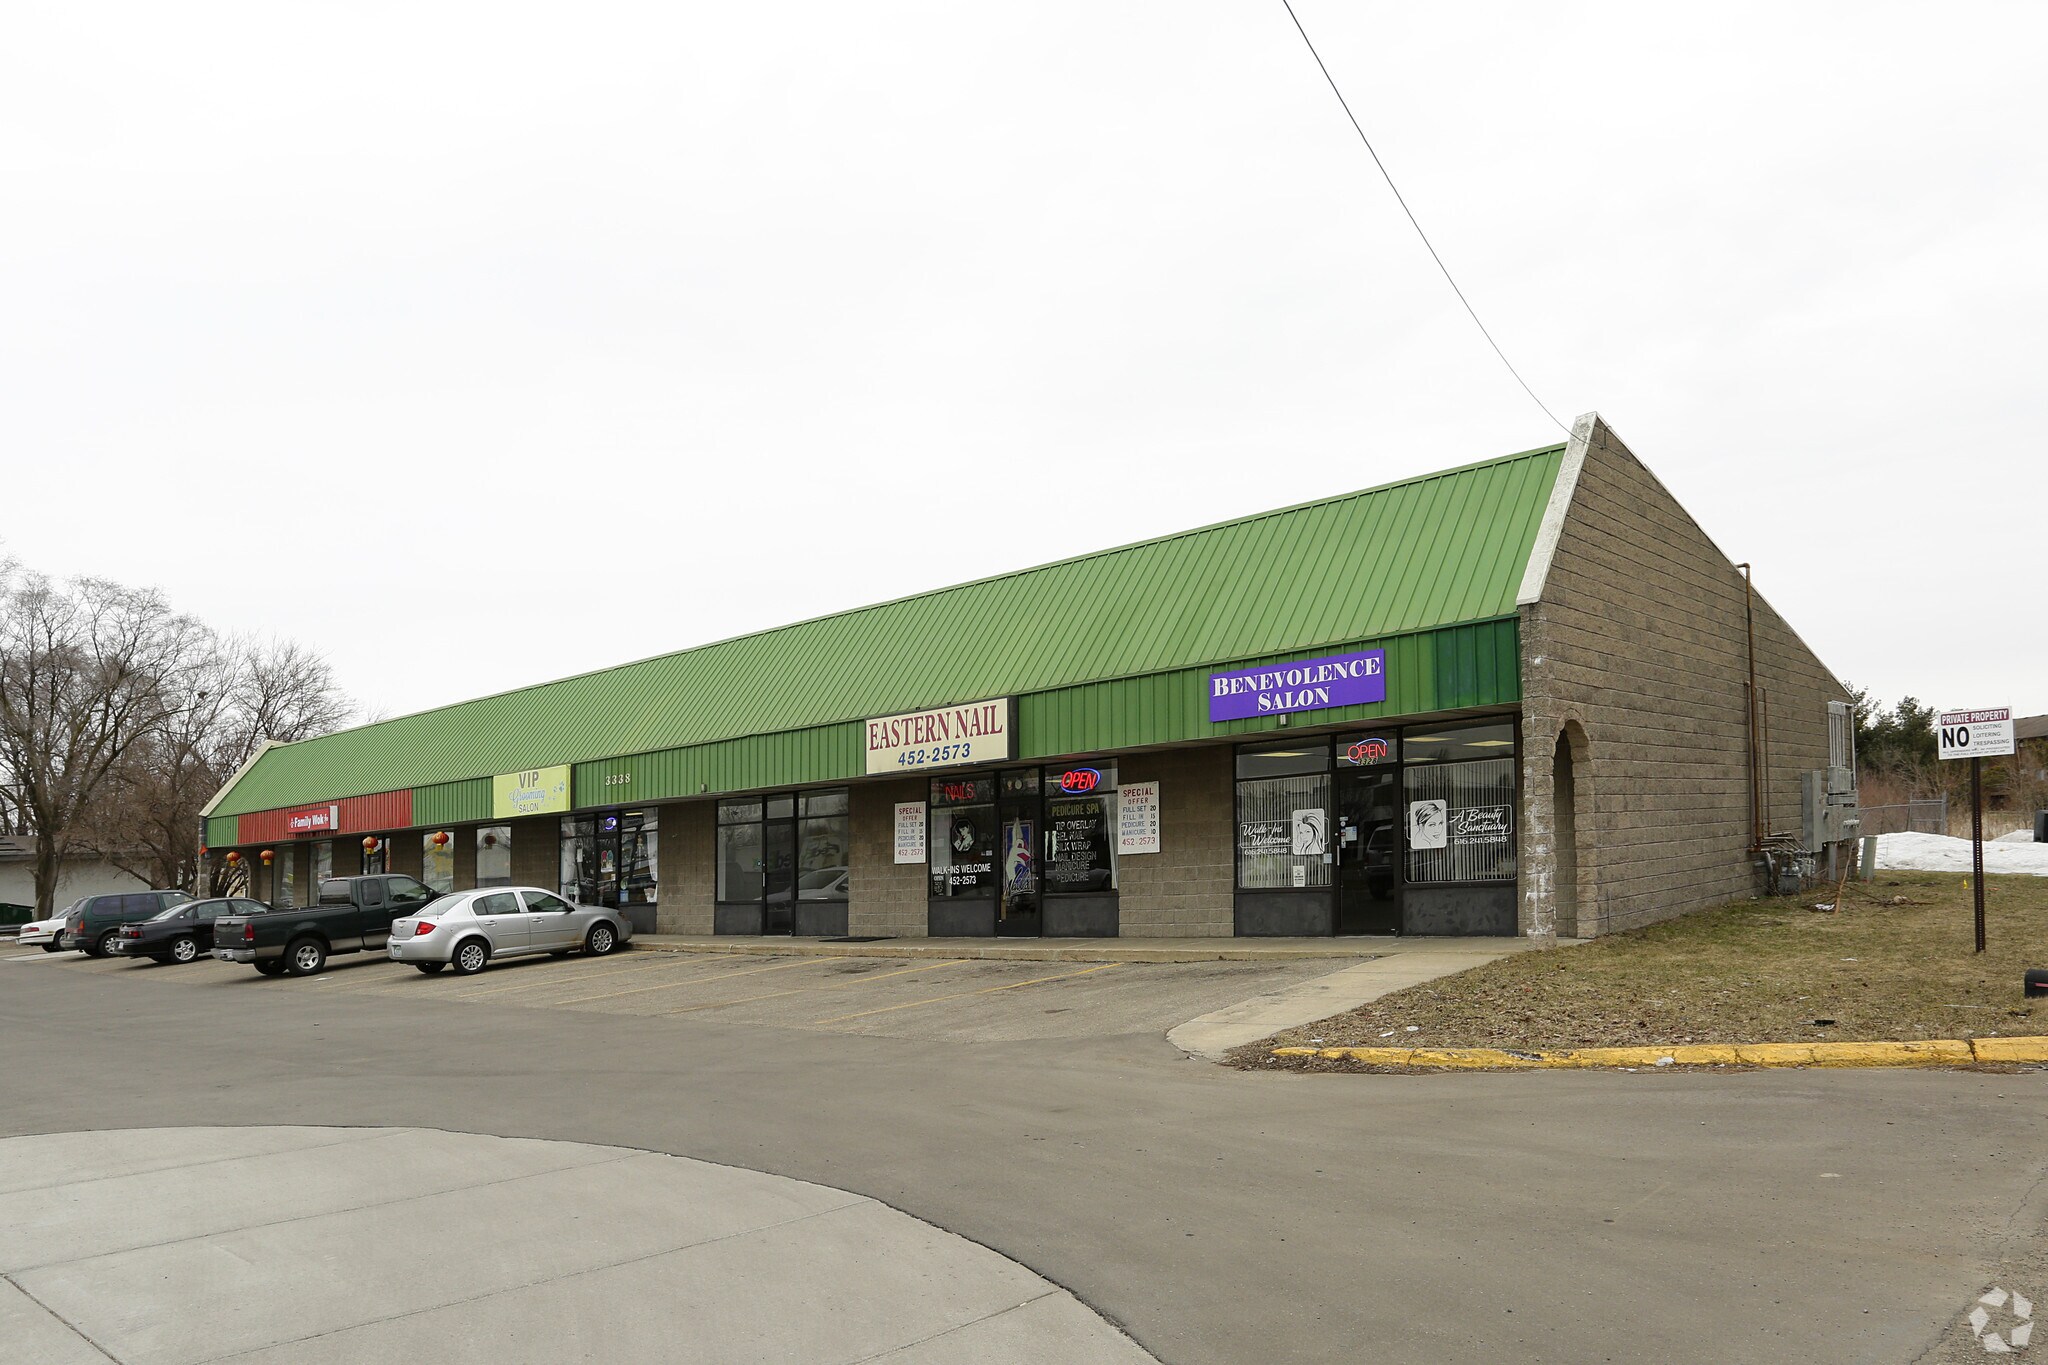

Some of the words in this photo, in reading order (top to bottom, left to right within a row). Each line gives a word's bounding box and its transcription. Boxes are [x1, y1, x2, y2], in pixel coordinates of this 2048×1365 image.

[1213, 657, 1381, 697] BENEVOLENCE
[1258, 686, 1330, 712] SALON
[1941, 713, 1969, 725] PRIVATE
[1970, 710, 2008, 722] PROPERTY
[869, 712, 951, 750] EASTERN
[955, 705, 1003, 739] NAIL
[1942, 726, 1970, 748] NO
[898, 743, 971, 766] 452-2573
[1347, 743, 1387, 760] OPEN
[519, 771, 539, 789] VIP
[605, 773, 631, 786] 3338
[1062, 771, 1097, 790] OPEN
[509, 787, 546, 808] Grooming
[944, 783, 975, 801] NAILS
[1123, 787, 1154, 797] SPECIAL
[518, 802, 539, 814] SALON
[1128, 797, 1149, 805] OFFER
[1149, 804, 1157, 812] 20
[1052, 804, 1084, 817] PEDICURE
[1086, 803, 1100, 814] SPA
[1449, 809, 1465, 822] A
[1466, 807, 1504, 823] Beauty
[294, 815, 311, 829] Family
[312, 813, 324, 825] Wok
[1055, 821, 1066, 831] TIP
[1066, 819, 1097, 830] OVERLAY
[1121, 821, 1145, 829] PEDICURE
[1456, 820, 1508, 835] Sanctuary
[1121, 829, 1147, 837] MANICURE
[1241, 823, 1283, 836] Walk-Ins
[1055, 842, 1070, 852] SILK
[1070, 841, 1091, 851] WRAP
[1250, 834, 1292, 846] Welcome
[1071, 851, 1097, 861] DESIGN
[932, 865, 960, 875] WALK-INS
[960, 863, 992, 874] WELCOME
[949, 875, 977, 885] 452-2573
